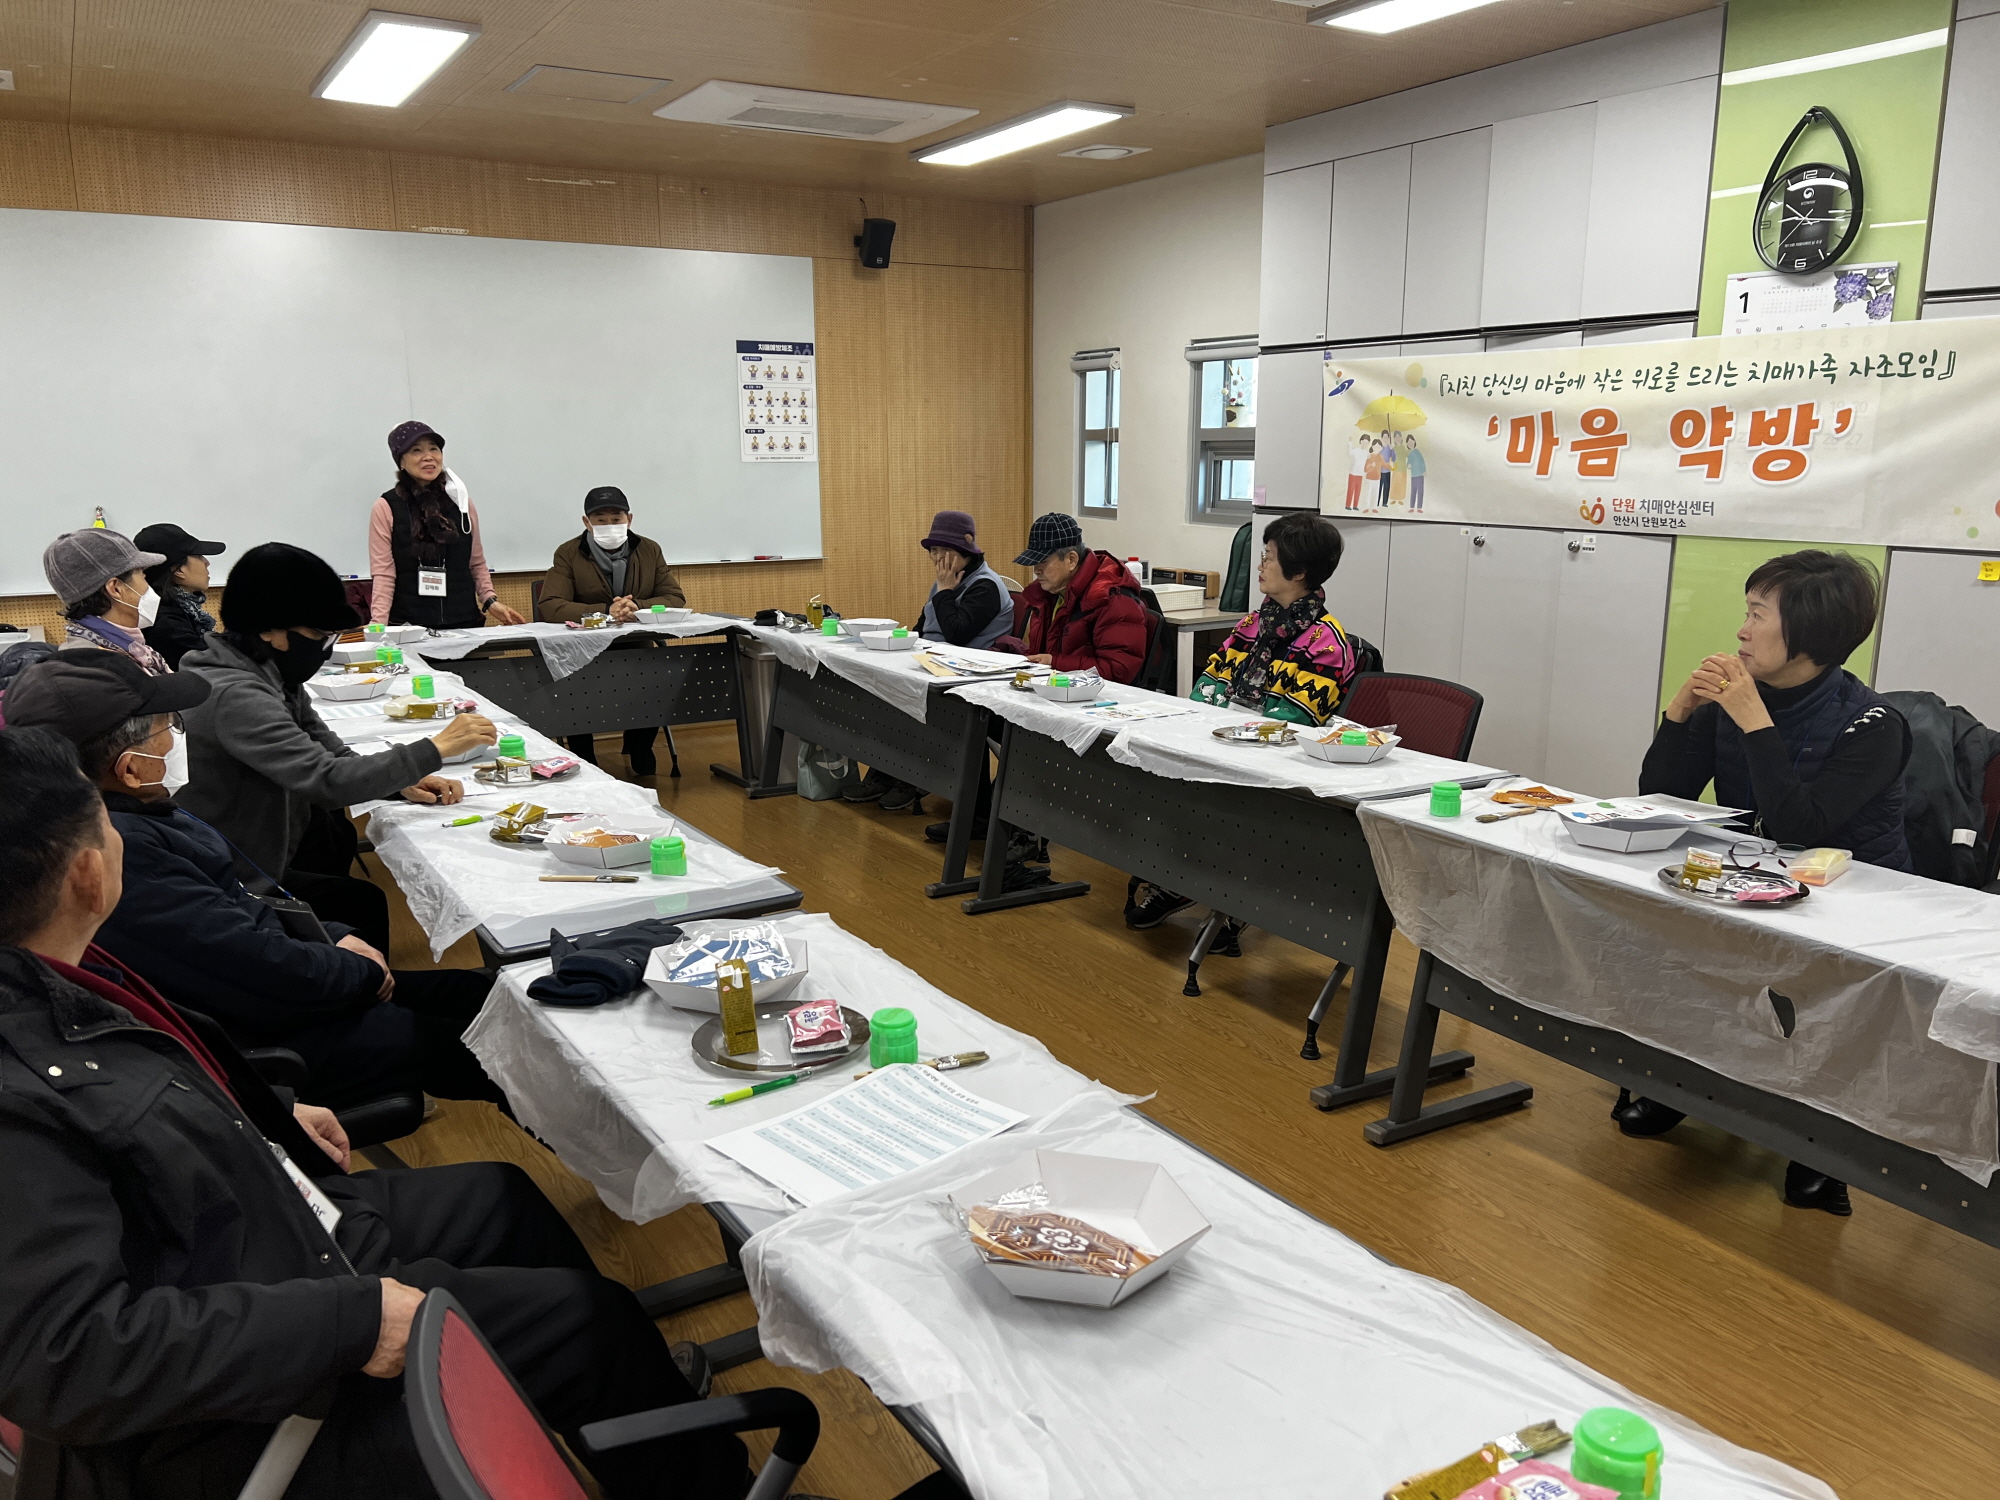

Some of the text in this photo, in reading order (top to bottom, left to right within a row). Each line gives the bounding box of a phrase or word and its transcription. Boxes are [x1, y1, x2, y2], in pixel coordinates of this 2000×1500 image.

[1802, 169, 1818, 180] 12
[1794, 258, 1807, 269] 6
[1739, 291, 1749, 314] 1
[1440, 348, 1957, 397] 『지친 당신의 마음에 작은 위로를 드리는 치매가족 자조모임』
[1611, 498, 1715, 516] 단원 치매안심센터
[1613, 515, 1687, 528] 안산시 단원보건소
